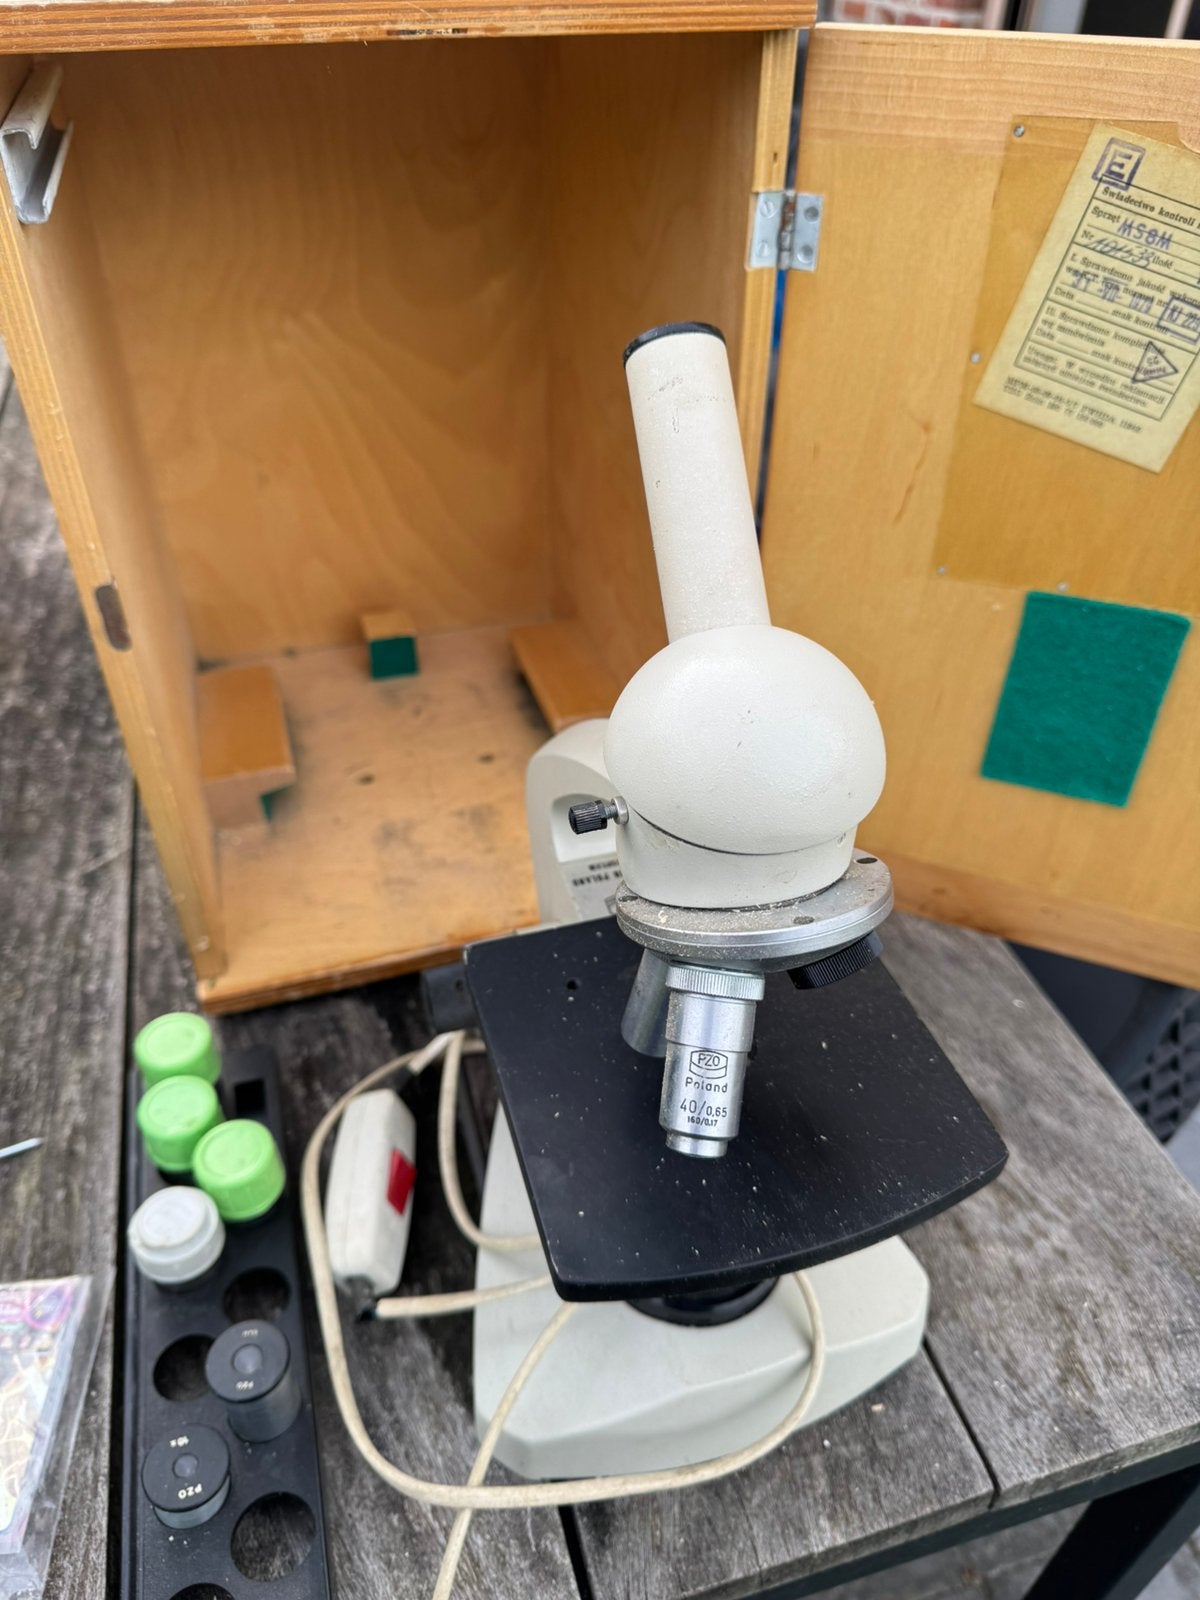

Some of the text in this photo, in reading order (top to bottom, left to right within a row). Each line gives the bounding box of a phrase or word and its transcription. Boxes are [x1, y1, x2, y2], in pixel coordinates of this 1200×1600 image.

[1158, 207, 1194, 226] kontroli
[1081, 230, 1094, 240] Nr
[698, 1053, 721, 1067] PZO
[685, 1077, 728, 1093] Poland
[177, 1483, 203, 1500] PZO
